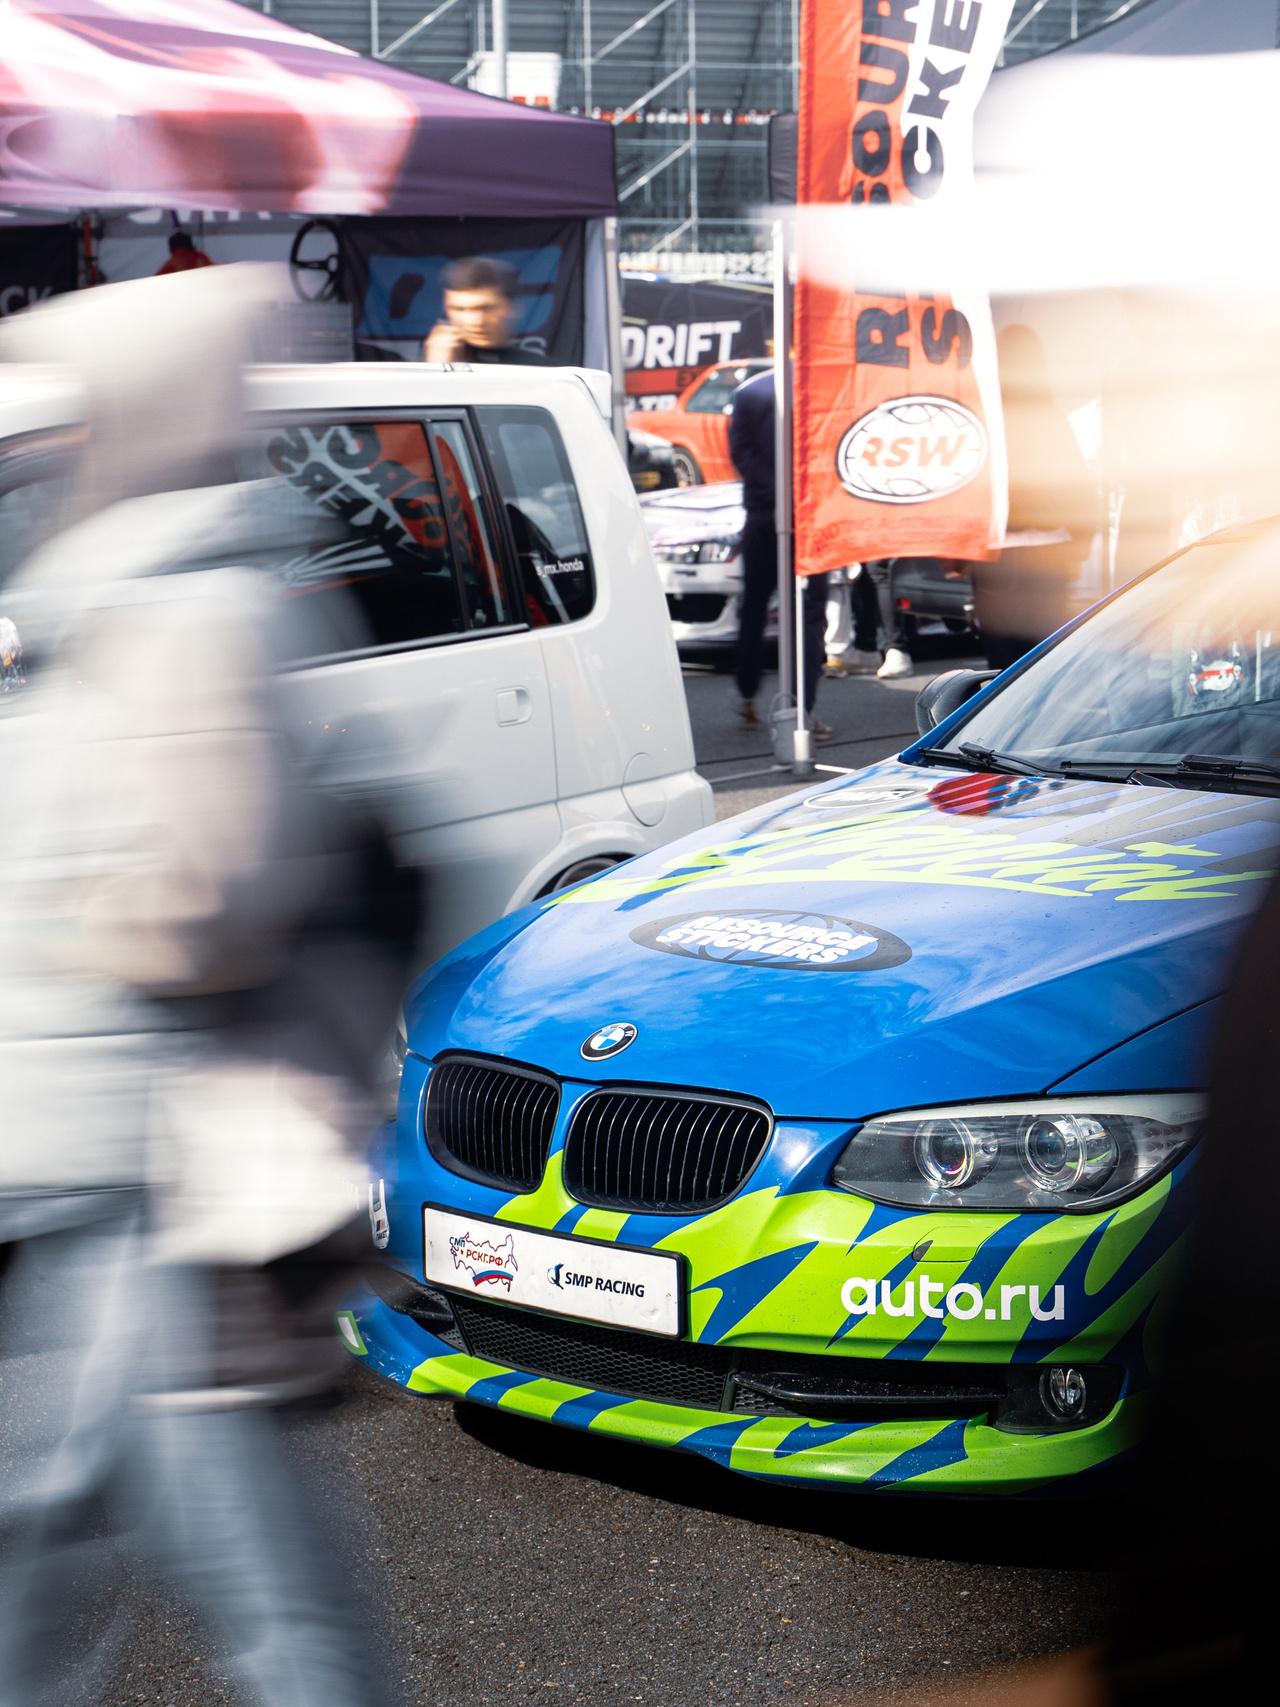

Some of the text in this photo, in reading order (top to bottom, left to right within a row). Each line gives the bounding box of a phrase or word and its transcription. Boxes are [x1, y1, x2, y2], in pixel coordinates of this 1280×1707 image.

[620, 320, 742, 369] DRIFT
[861, 434, 969, 467] RSW
[655, 928, 849, 963] STICKERS
[680, 916, 878, 951] RESOURCE
[565, 1272, 645, 1298] SMP RACING
[841, 1274, 1065, 1321] auto.ru
